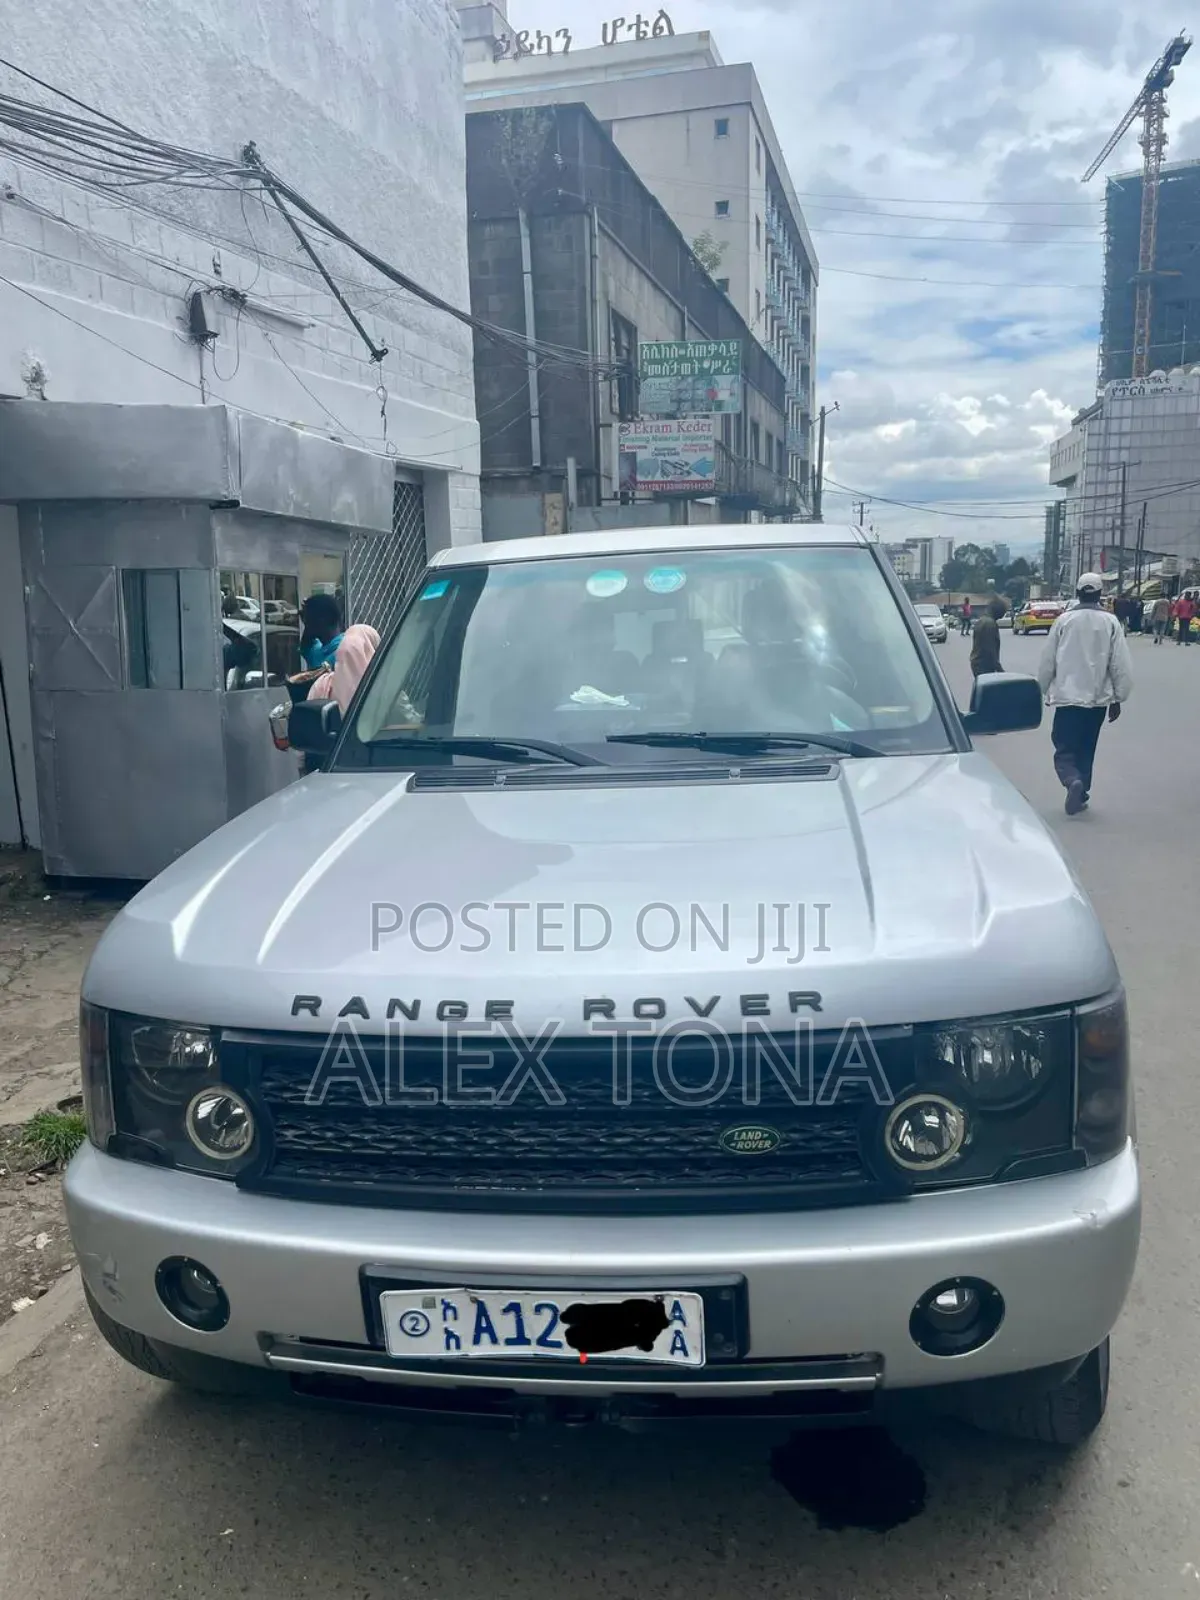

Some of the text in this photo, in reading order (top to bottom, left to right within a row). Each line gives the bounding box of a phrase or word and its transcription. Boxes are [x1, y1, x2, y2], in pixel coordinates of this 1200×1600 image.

[601, 9, 675, 46] ሆቴል
[634, 422, 672, 435] Ekram
[290, 990, 824, 1021] RANGE ROVER
